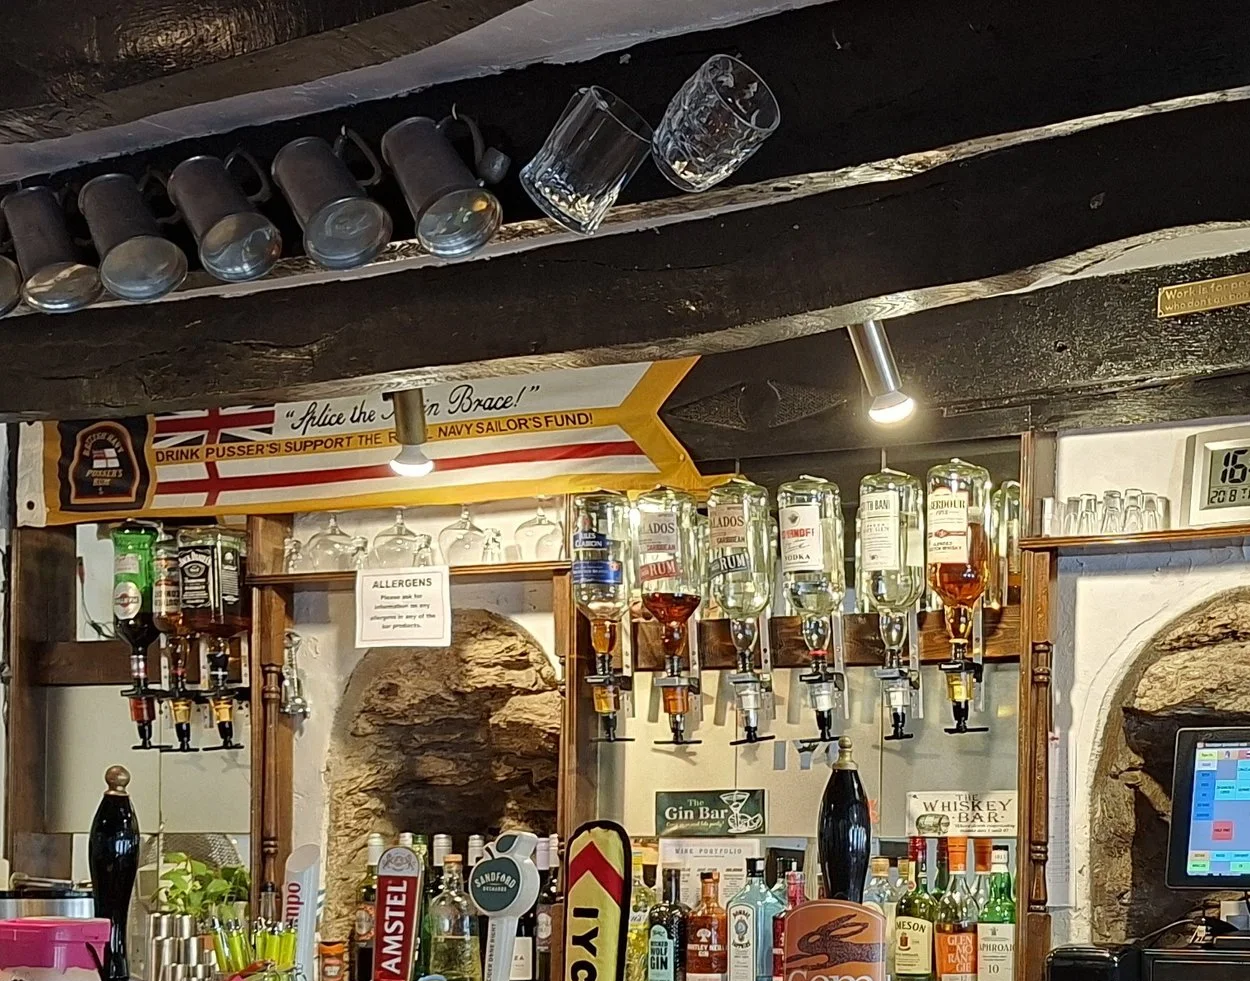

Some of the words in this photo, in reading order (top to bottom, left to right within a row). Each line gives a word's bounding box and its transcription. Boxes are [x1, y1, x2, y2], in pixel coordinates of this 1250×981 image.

[1165, 286, 1195, 300] Work
[1198, 284, 1208, 294] is
[1210, 282, 1228, 292] for
[1164, 302, 1186, 311] who
[1187, 295, 1211, 308] don't
[350, 400, 376, 423] the
[437, 424, 473, 438] NAVY
[476, 416, 543, 434] SAILOR'S
[545, 413, 593, 428] FUND!
[156, 449, 200, 463] DRINK
[284, 436, 355, 454] SUPPORT
[358, 432, 381, 446] THE
[649, 559, 675, 576] RUM
[719, 552, 746, 570] RUM
[372, 578, 432, 589] ALLERGENS
[370, 614, 397, 622] allergens
[687, 798, 705, 807] The
[955, 793, 979, 801] THE
[923, 799, 1013, 812] WHISKEY
[664, 806, 695, 820] Gin
[699, 806, 729, 820] Bar
[958, 811, 999, 823] BAR
[474, 871, 517, 889] SANDFORD
[381, 879, 408, 975] AMSTEL
[947, 935, 973, 946] GLEN
[650, 947, 668, 956] WOLF
[650, 956, 668, 970] GIN
[988, 964, 999, 974] 10
